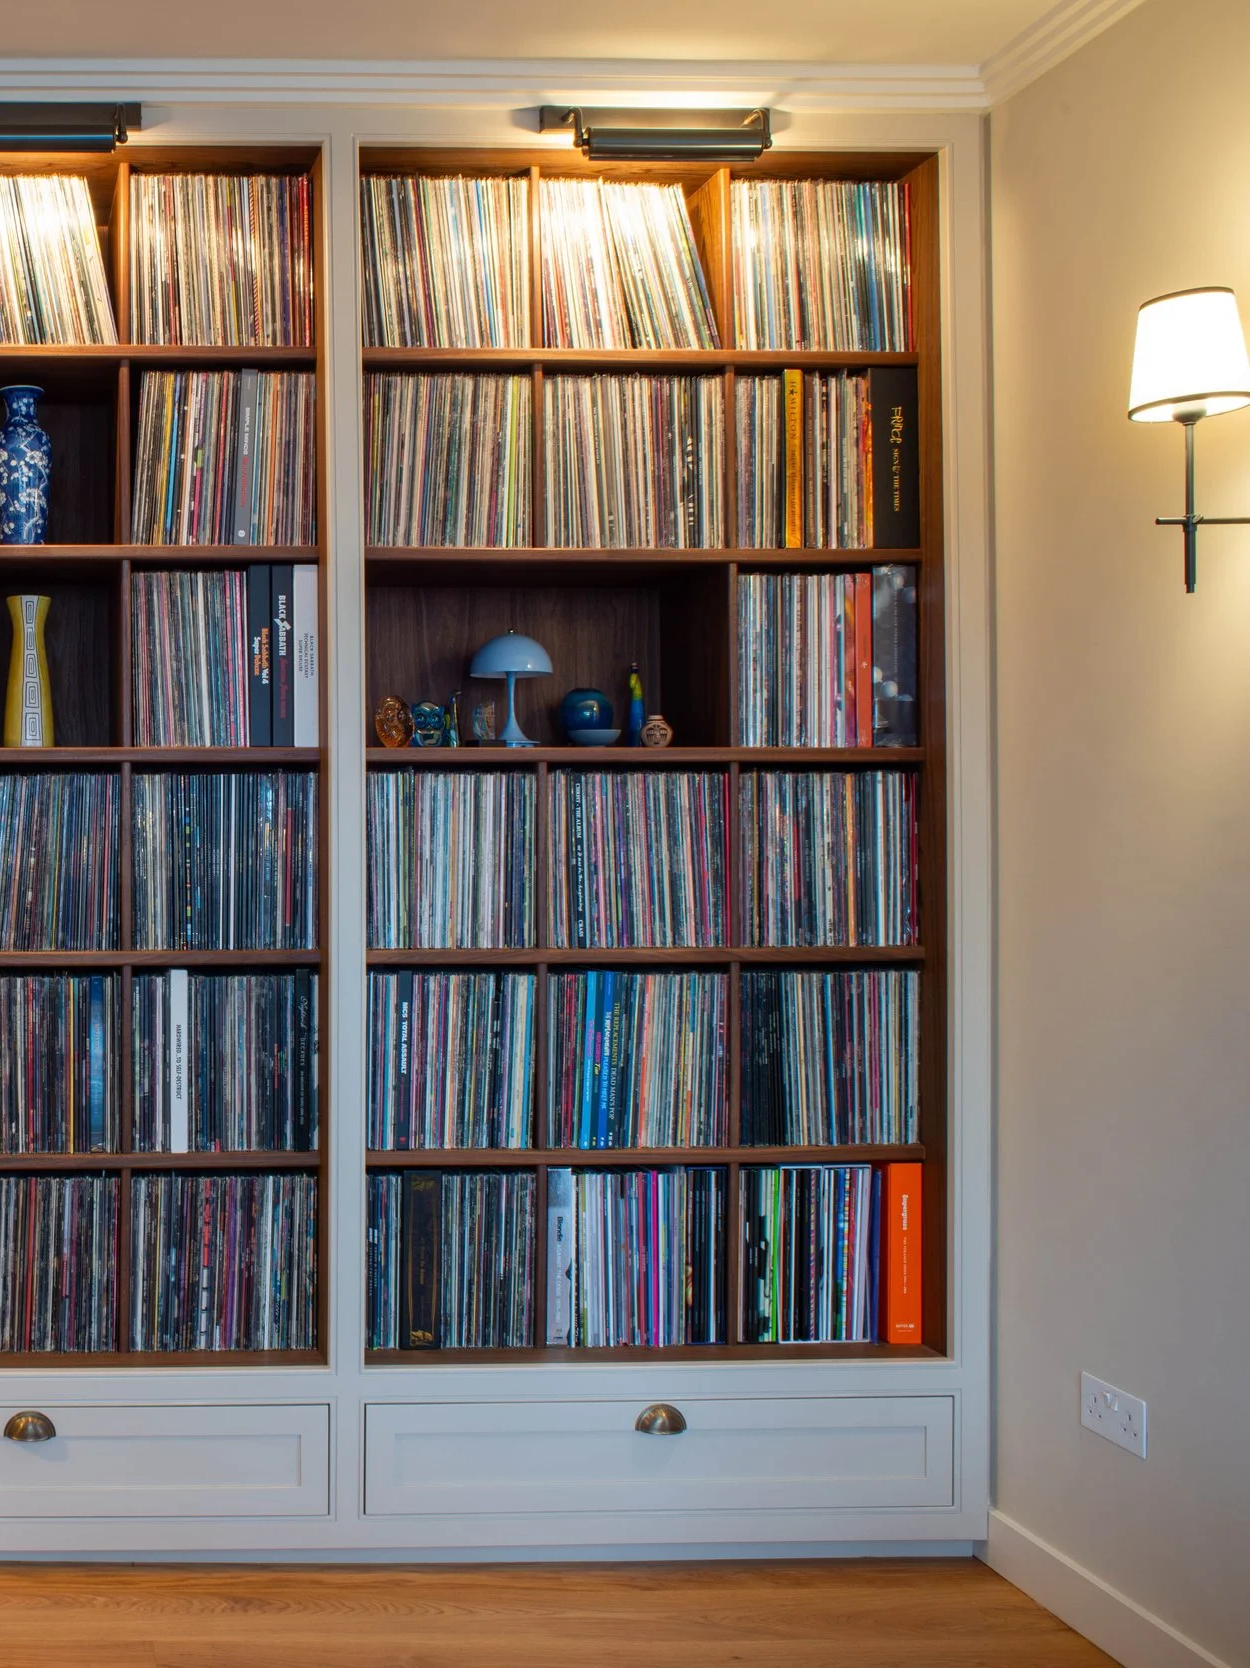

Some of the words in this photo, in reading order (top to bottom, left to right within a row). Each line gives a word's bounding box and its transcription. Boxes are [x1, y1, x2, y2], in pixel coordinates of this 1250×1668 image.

[890, 407, 904, 444] PRINCE
[892, 448, 900, 465] SIGN
[278, 595, 287, 619] BLACK
[252, 636, 261, 655] Super
[273, 619, 292, 656] SABBATH
[261, 644, 269, 669] Sabbath
[261, 668, 269, 679] Vol
[401, 1001, 409, 1018] MC5
[611, 1016, 619, 1065] REPLACEMENTS
[400, 1043, 408, 1075] ASSAULT
[602, 1056, 610, 1080] PLEASED
[175, 1064, 183, 1100] SELF-DESTRUCT
[901, 1194, 909, 1231] Supergrass
[556, 1216, 564, 1242] Blondie
